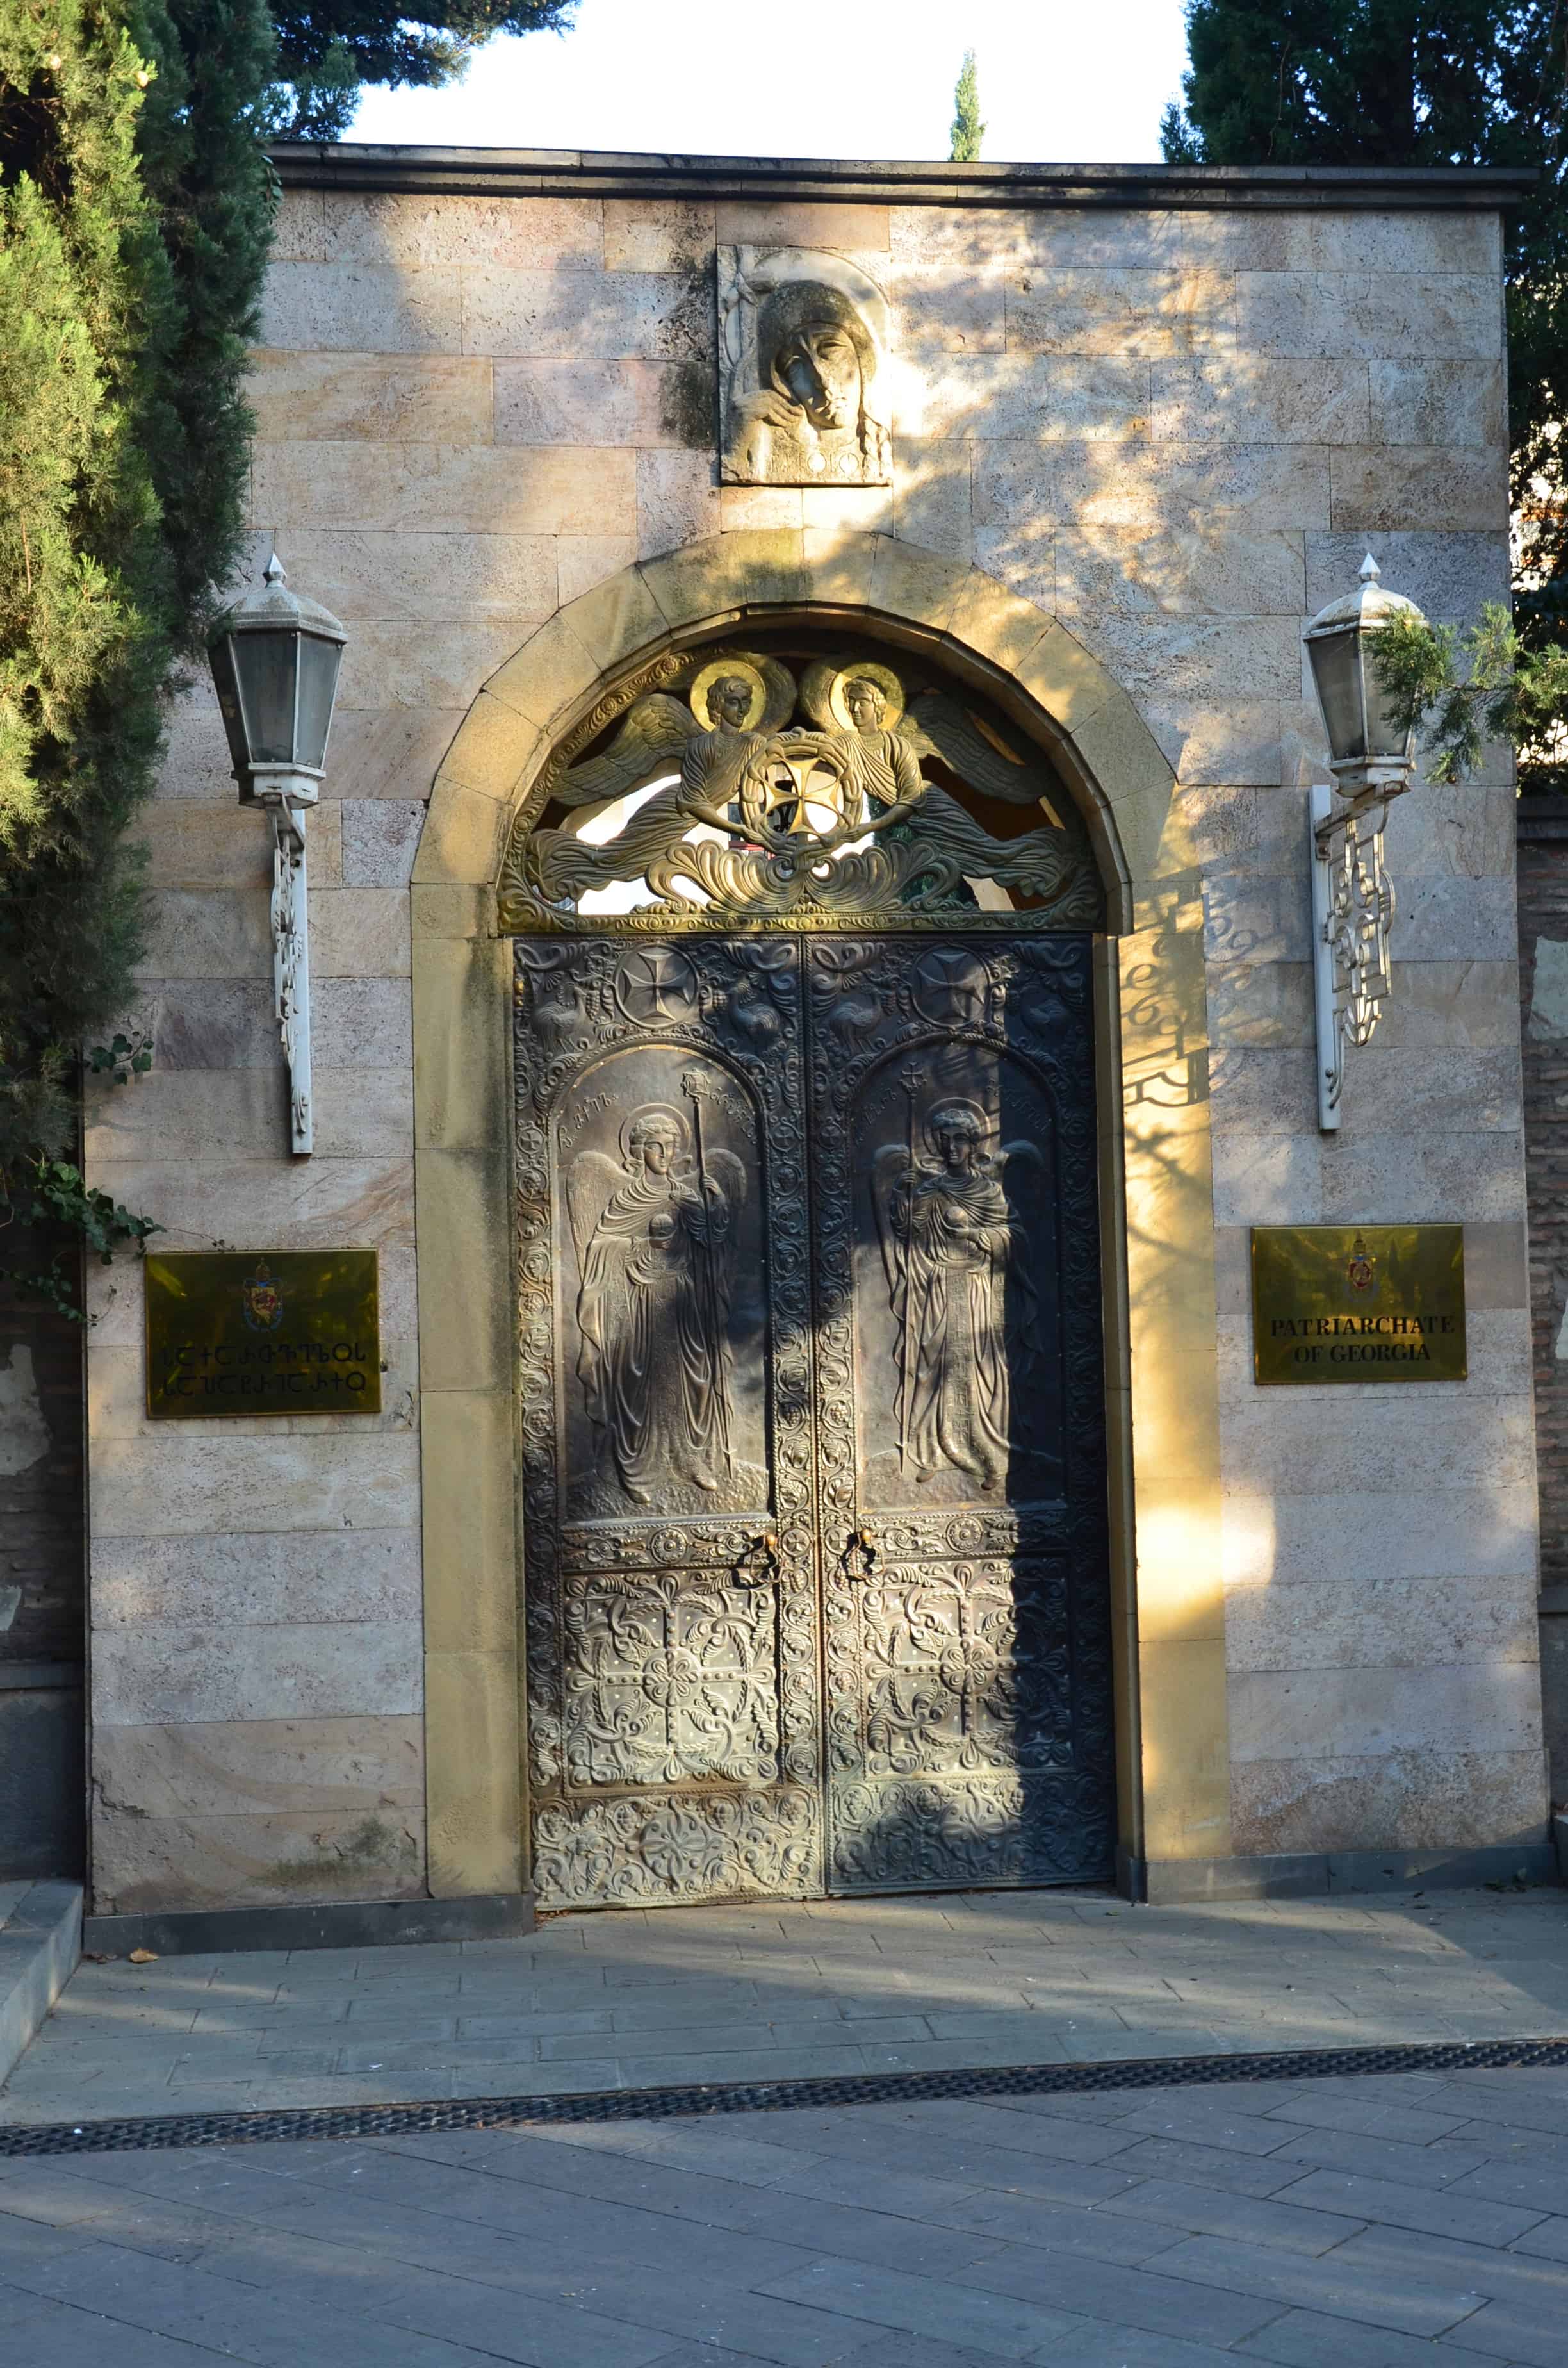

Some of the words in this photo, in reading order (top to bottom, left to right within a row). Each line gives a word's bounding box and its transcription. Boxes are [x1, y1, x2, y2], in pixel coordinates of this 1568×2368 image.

[1271, 1315, 1455, 1336] PATRIARCHATE
[1294, 1345, 1323, 1363] OF
[1330, 1343, 1430, 1363] GEORGIA
